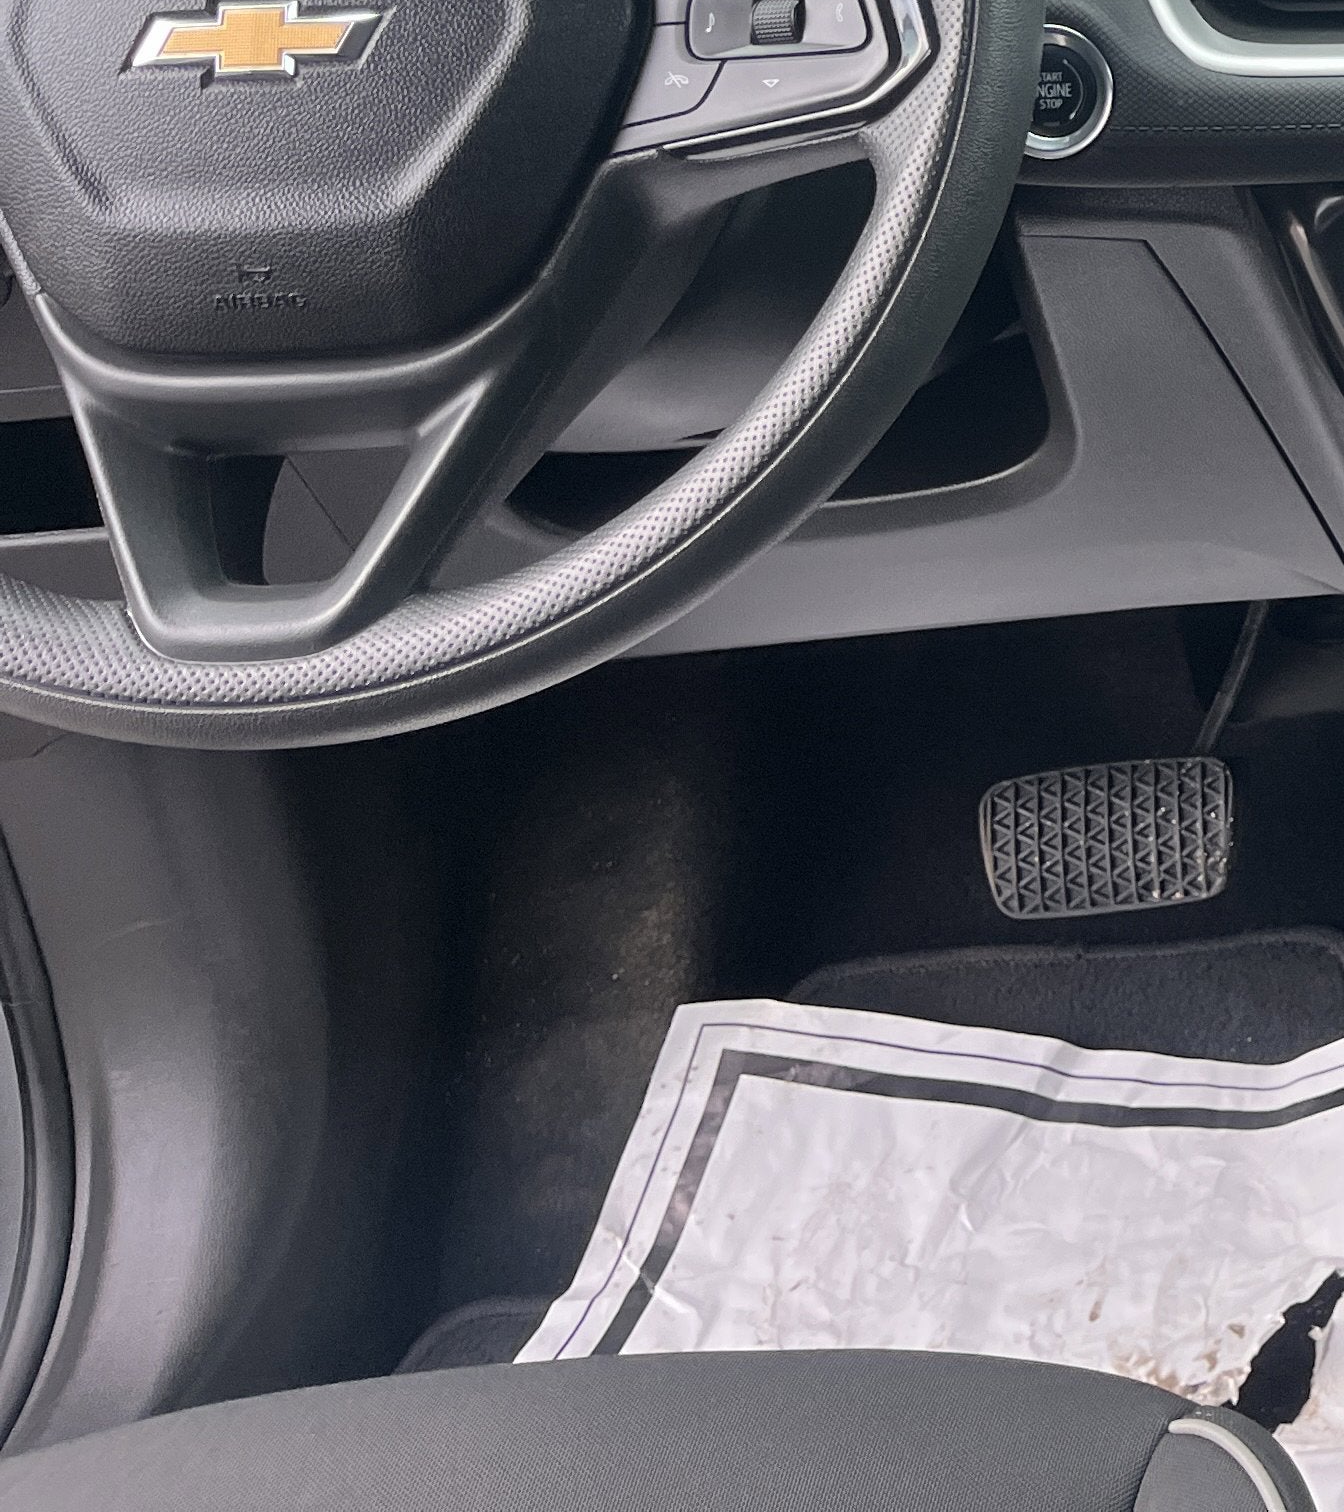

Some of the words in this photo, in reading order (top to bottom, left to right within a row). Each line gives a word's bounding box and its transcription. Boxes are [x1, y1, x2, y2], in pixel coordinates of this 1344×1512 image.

[1040, 71, 1063, 82] TART
[1036, 82, 1072, 98] NGINE
[1040, 98, 1063, 109] STOP
